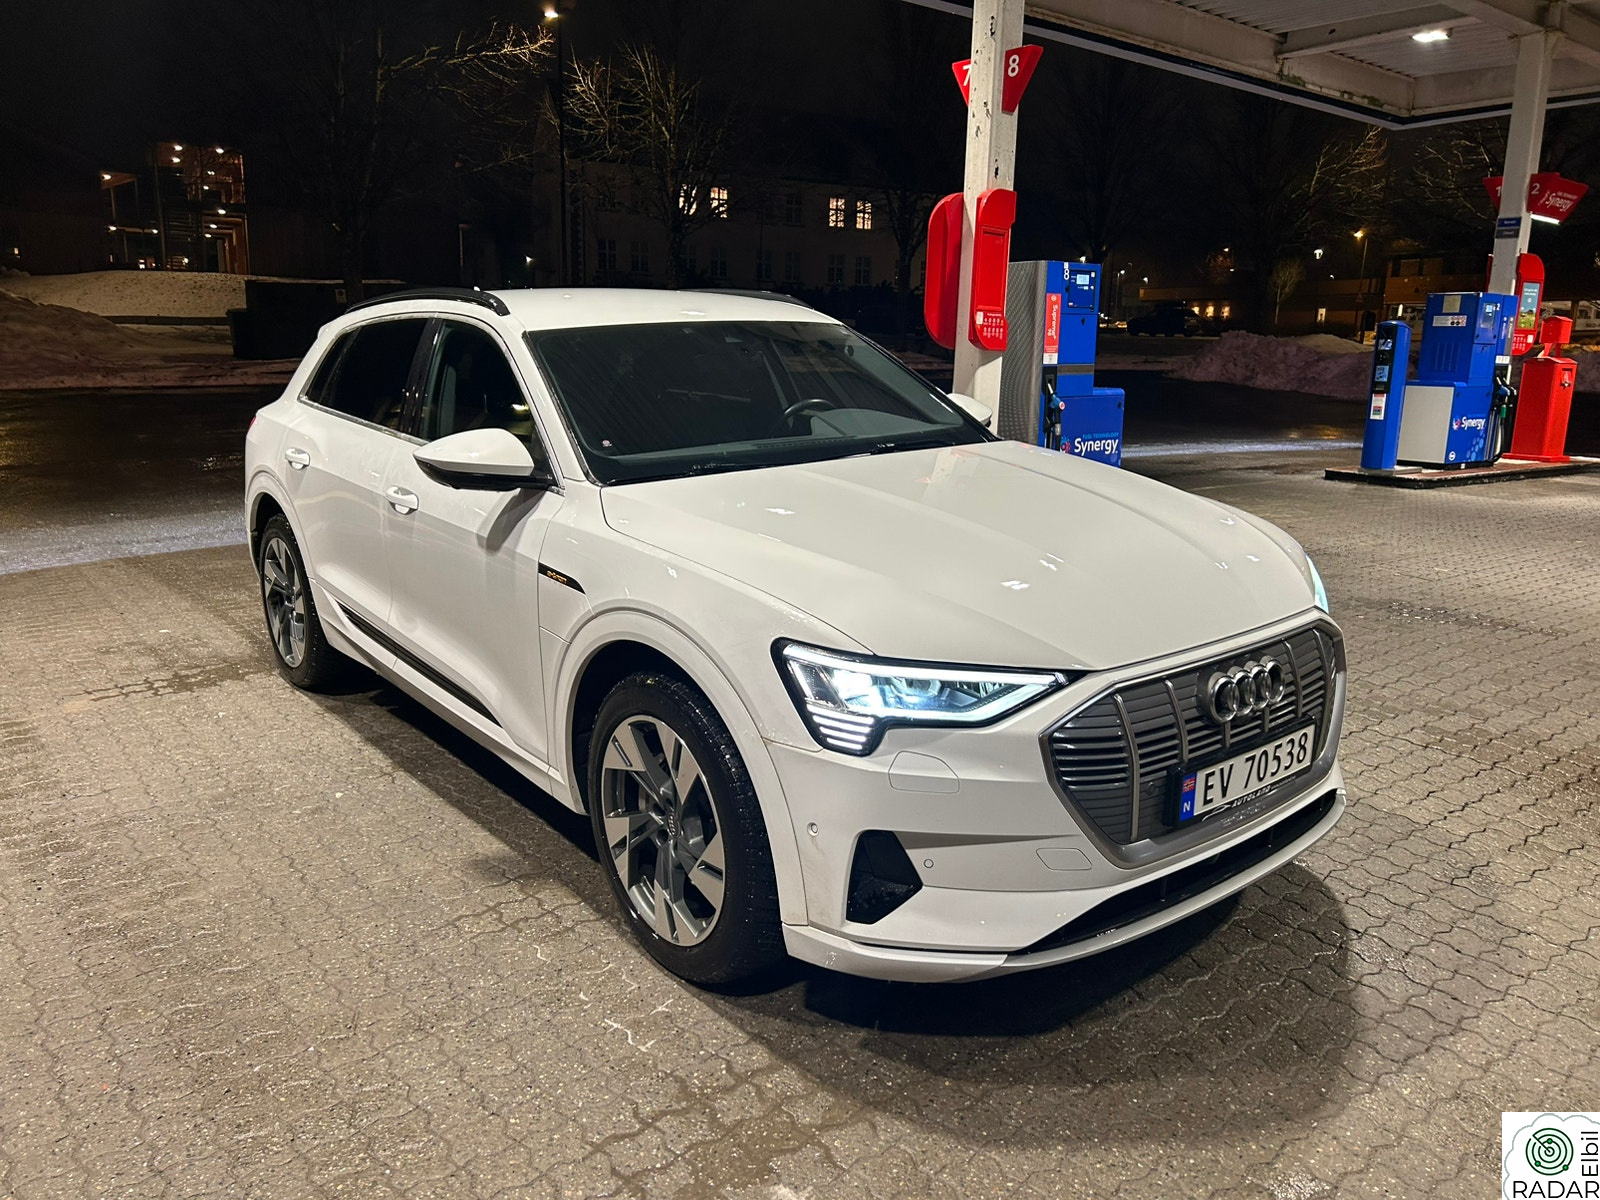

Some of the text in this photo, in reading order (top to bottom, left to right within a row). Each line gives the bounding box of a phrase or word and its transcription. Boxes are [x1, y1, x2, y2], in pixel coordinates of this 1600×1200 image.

[962, 64, 971, 86] 7
[1007, 55, 1019, 77] 8
[1531, 183, 1540, 194] 2
[1545, 192, 1574, 212] Synergy
[1063, 268, 1070, 280] 8
[1461, 416, 1486, 431] Synergy
[1074, 437, 1119, 456] Synergy
[1203, 731, 1308, 806] EV 70538
[1183, 801, 1191, 813] N
